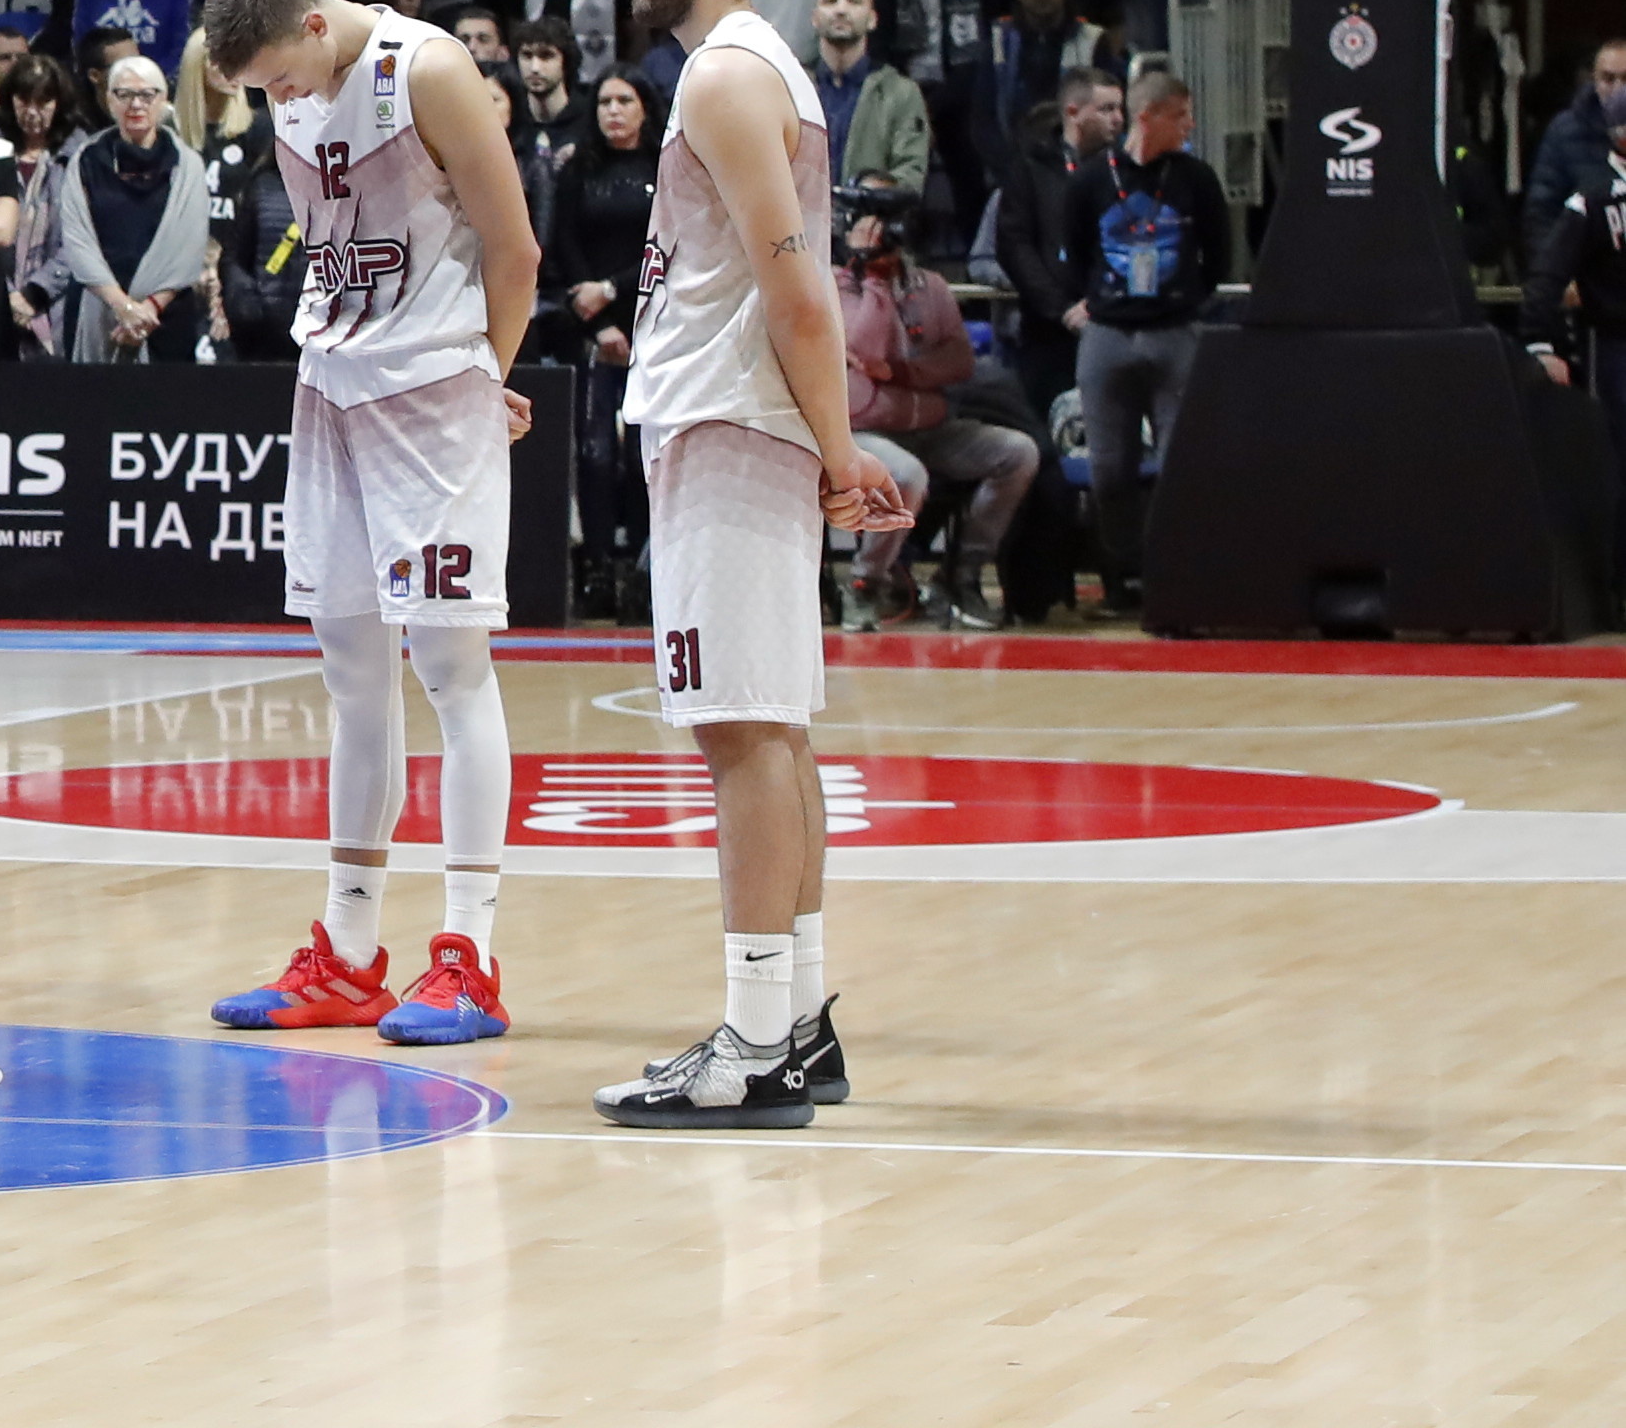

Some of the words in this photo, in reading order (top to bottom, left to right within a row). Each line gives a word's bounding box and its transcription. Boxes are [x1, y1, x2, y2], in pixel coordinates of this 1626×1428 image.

[375, 77, 395, 94] ABA
[314, 141, 352, 201] 12
[1326, 158, 1374, 181] NIS
[18, 529, 64, 548] NEFT
[109, 501, 191, 549] НА
[421, 543, 473, 600] 12
[666, 627, 702, 693] 31
